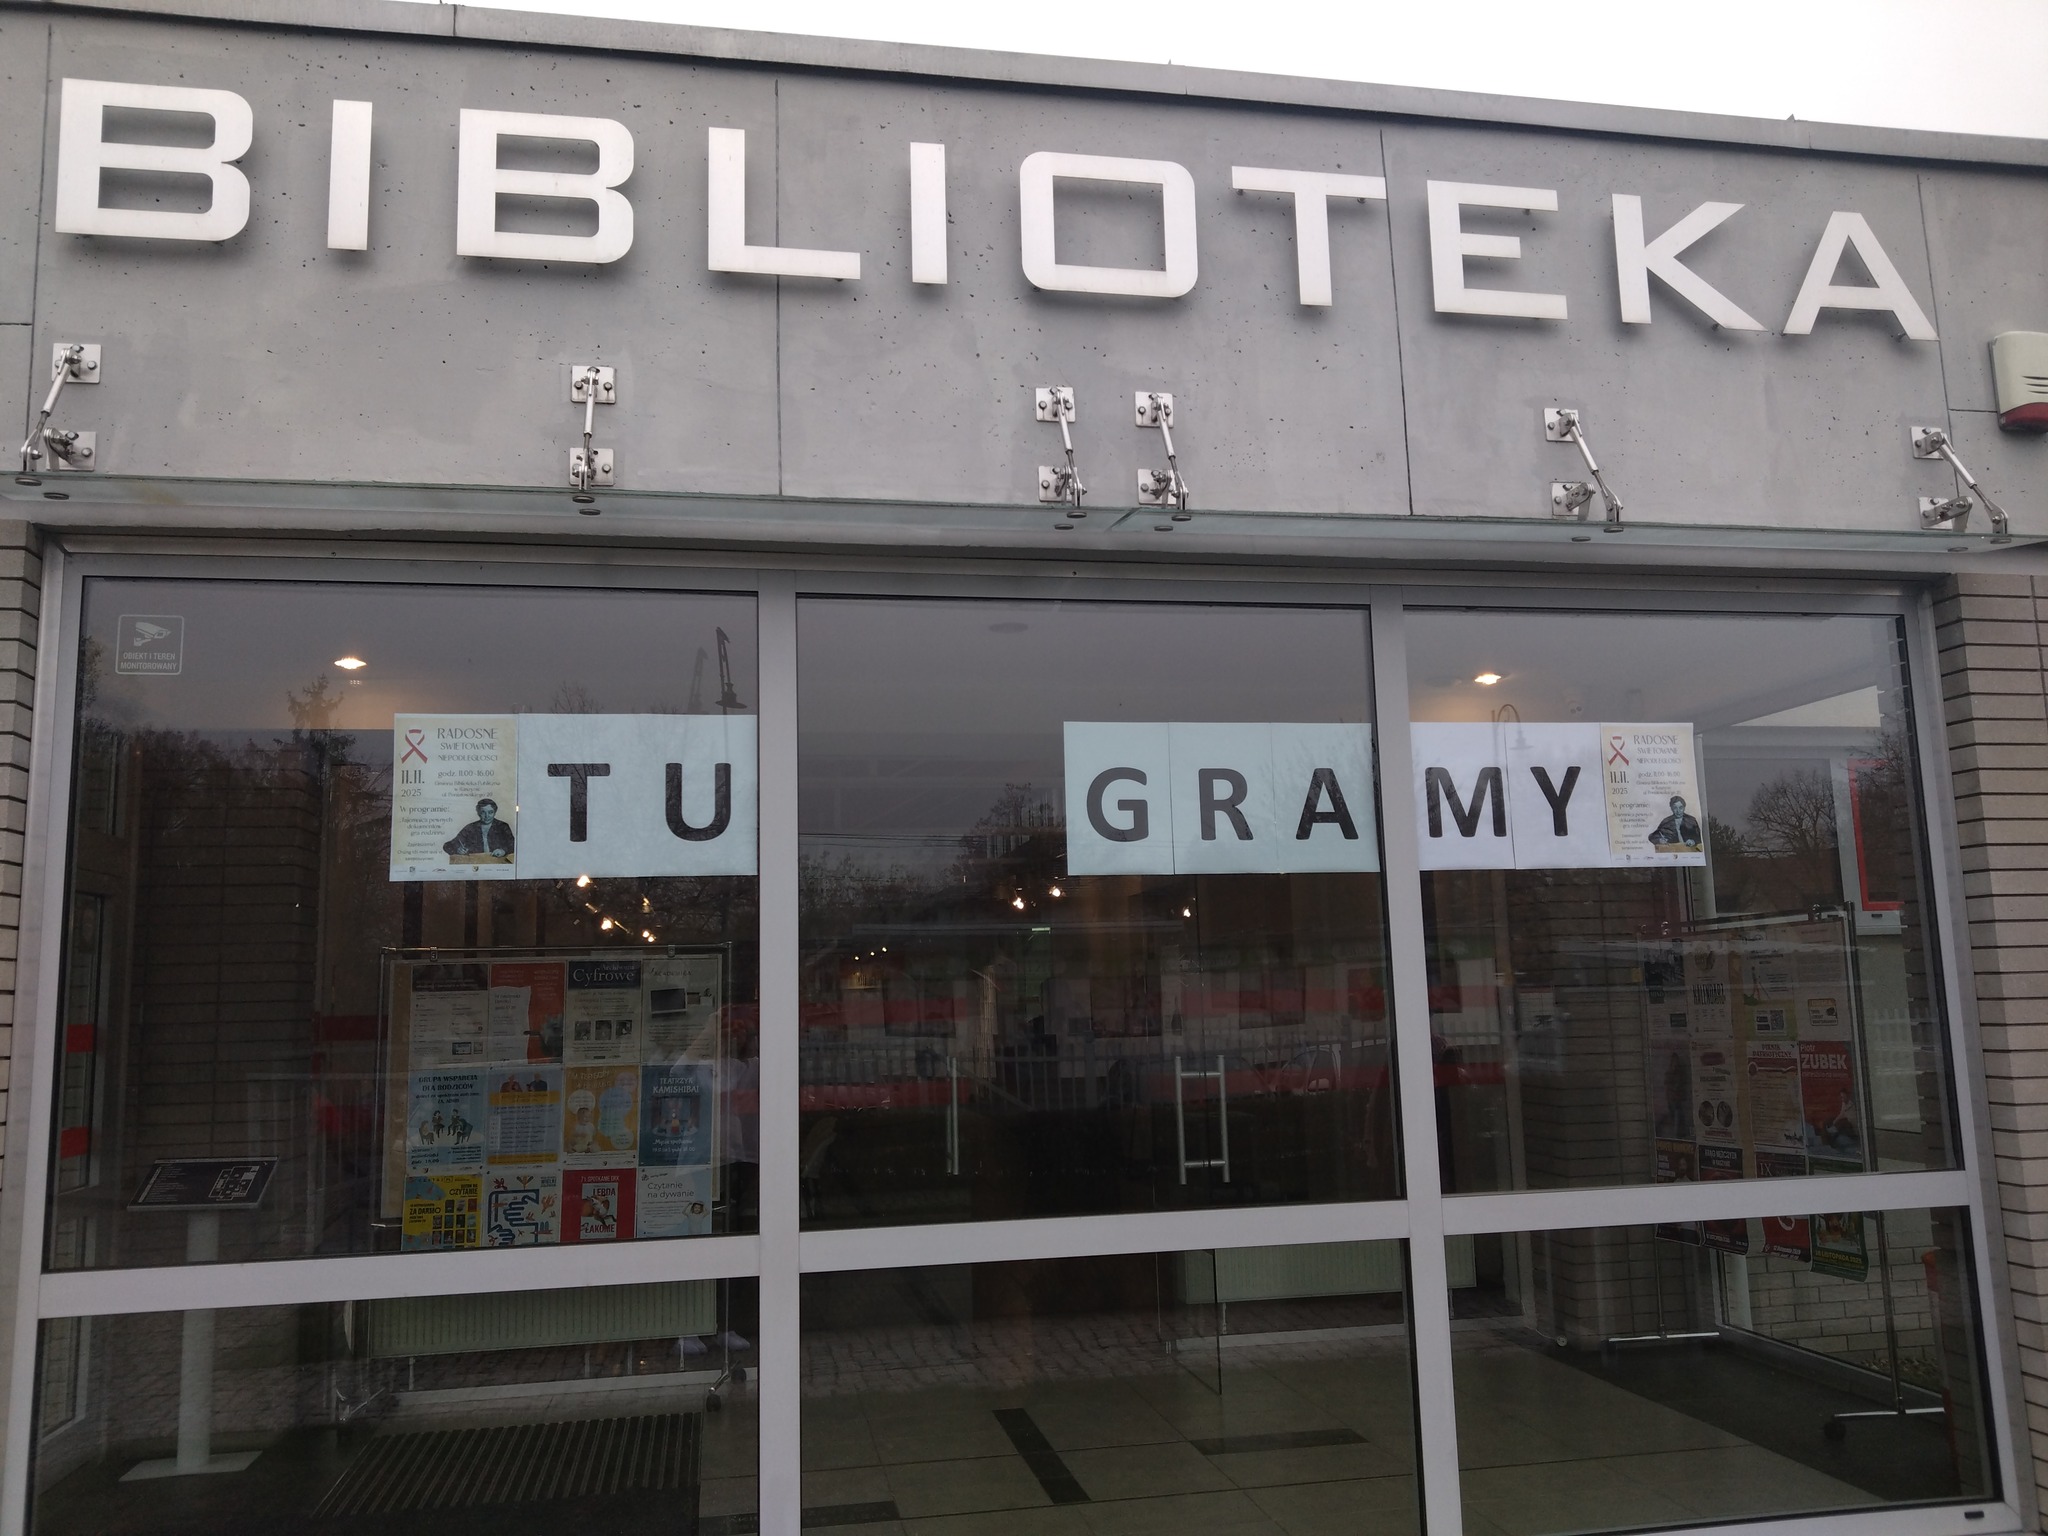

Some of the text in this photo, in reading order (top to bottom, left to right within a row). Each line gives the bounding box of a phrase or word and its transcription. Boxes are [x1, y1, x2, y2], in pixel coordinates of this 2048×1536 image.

[55, 77, 1940, 342] BIBLIOTEKA
[123, 652, 147, 660] OBIEKT
[120, 662, 177, 670] MONITOROWANY
[437, 727, 499, 740] RADOSNE
[1633, 734, 1680, 745] RADOSNE
[401, 769, 425, 785] 11.11.
[1609, 770, 1630, 784] 11.11.
[401, 788, 422, 798] 2025
[1612, 787, 1629, 796] 2025
[547, 762, 732, 843] TU
[573, 967, 635, 987] Cyfrowe
[1800, 1054, 1848, 1070] ZUBEK
[443, 1074, 478, 1082] WSPARCIA
[660, 1077, 694, 1085] TEATRZYK
[437, 1082, 473, 1091] RODZICÓW
[652, 1085, 700, 1094] KAMISHIBAI
[647, 1182, 683, 1191] Czytanie
[647, 1189, 695, 1199] na dywanie
